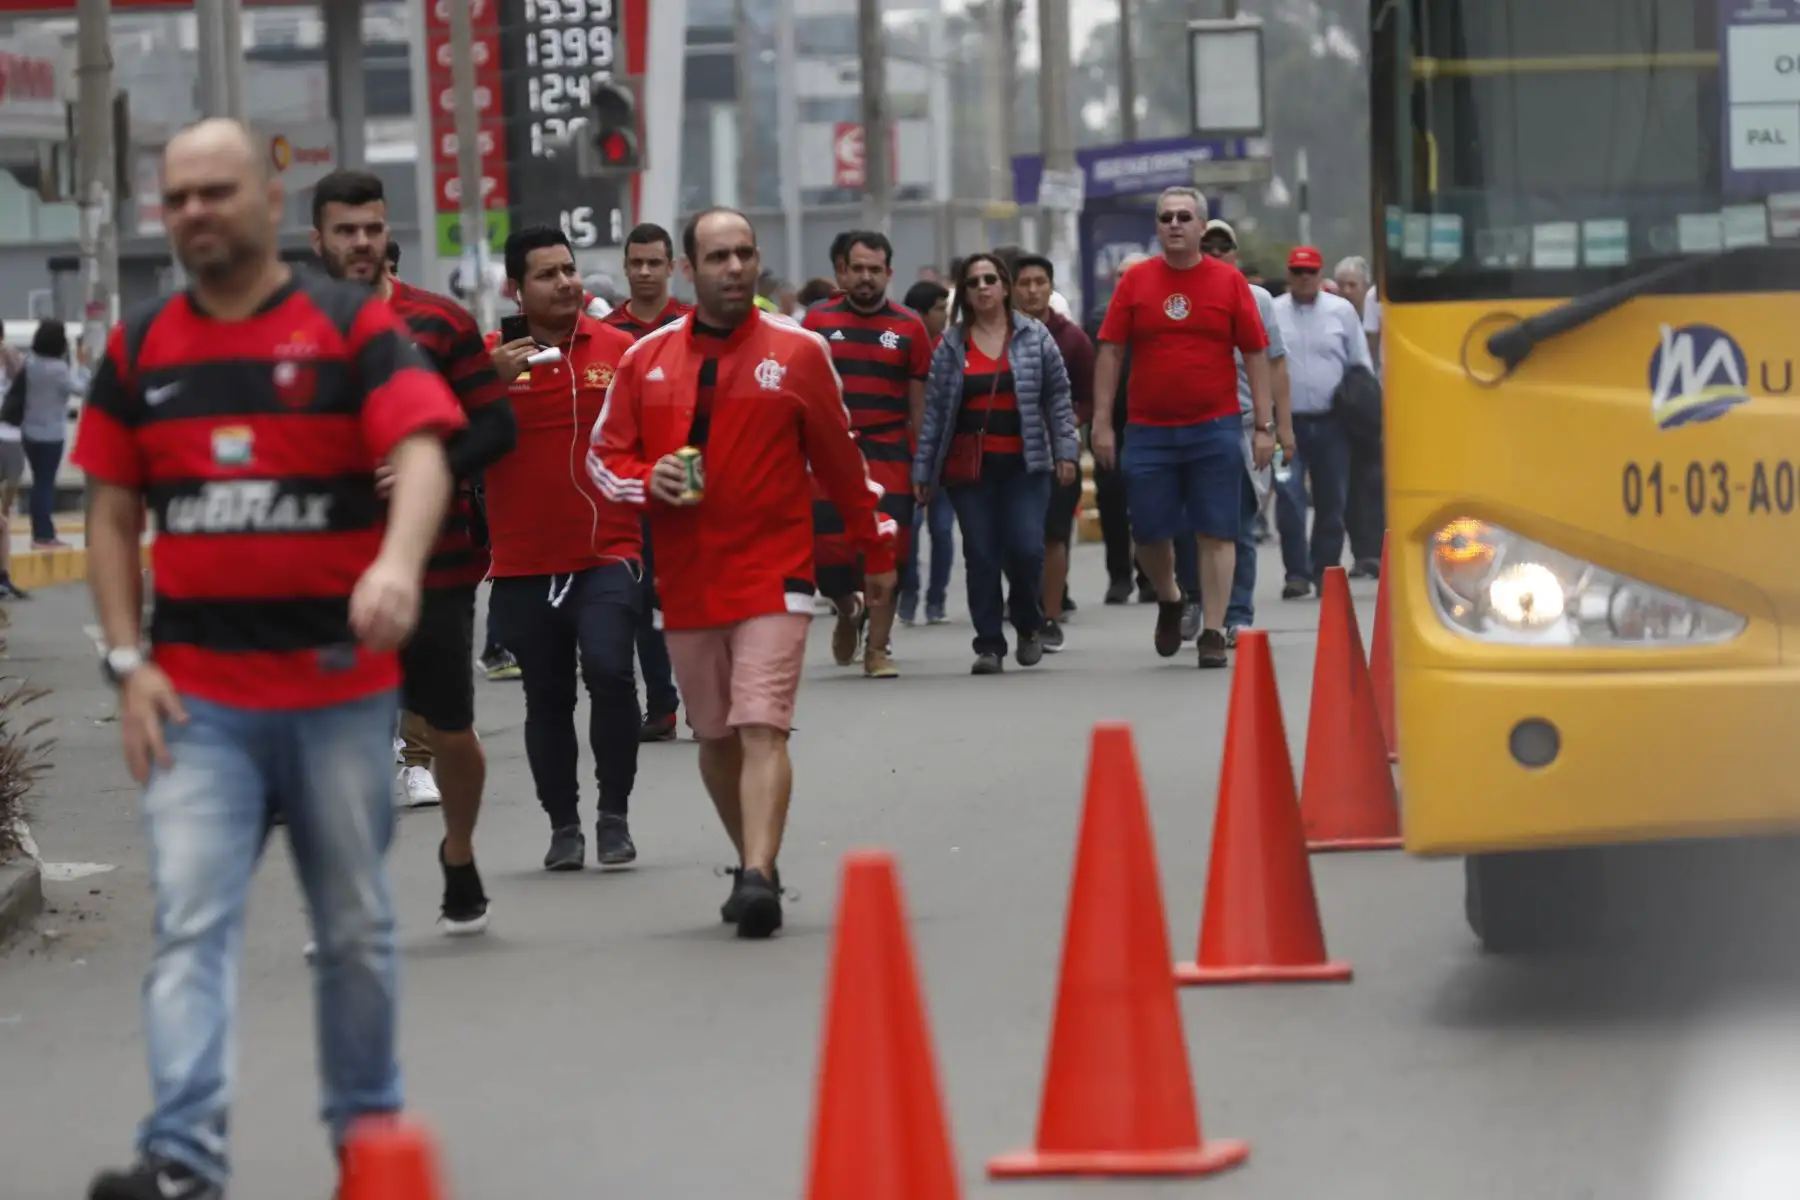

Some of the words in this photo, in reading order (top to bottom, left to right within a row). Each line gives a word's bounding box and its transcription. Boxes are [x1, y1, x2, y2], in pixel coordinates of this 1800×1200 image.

[1775, 54, 1800, 75] O
[1747, 129, 1787, 145] PAL
[1621, 460, 1800, 518] 01-03-A0
